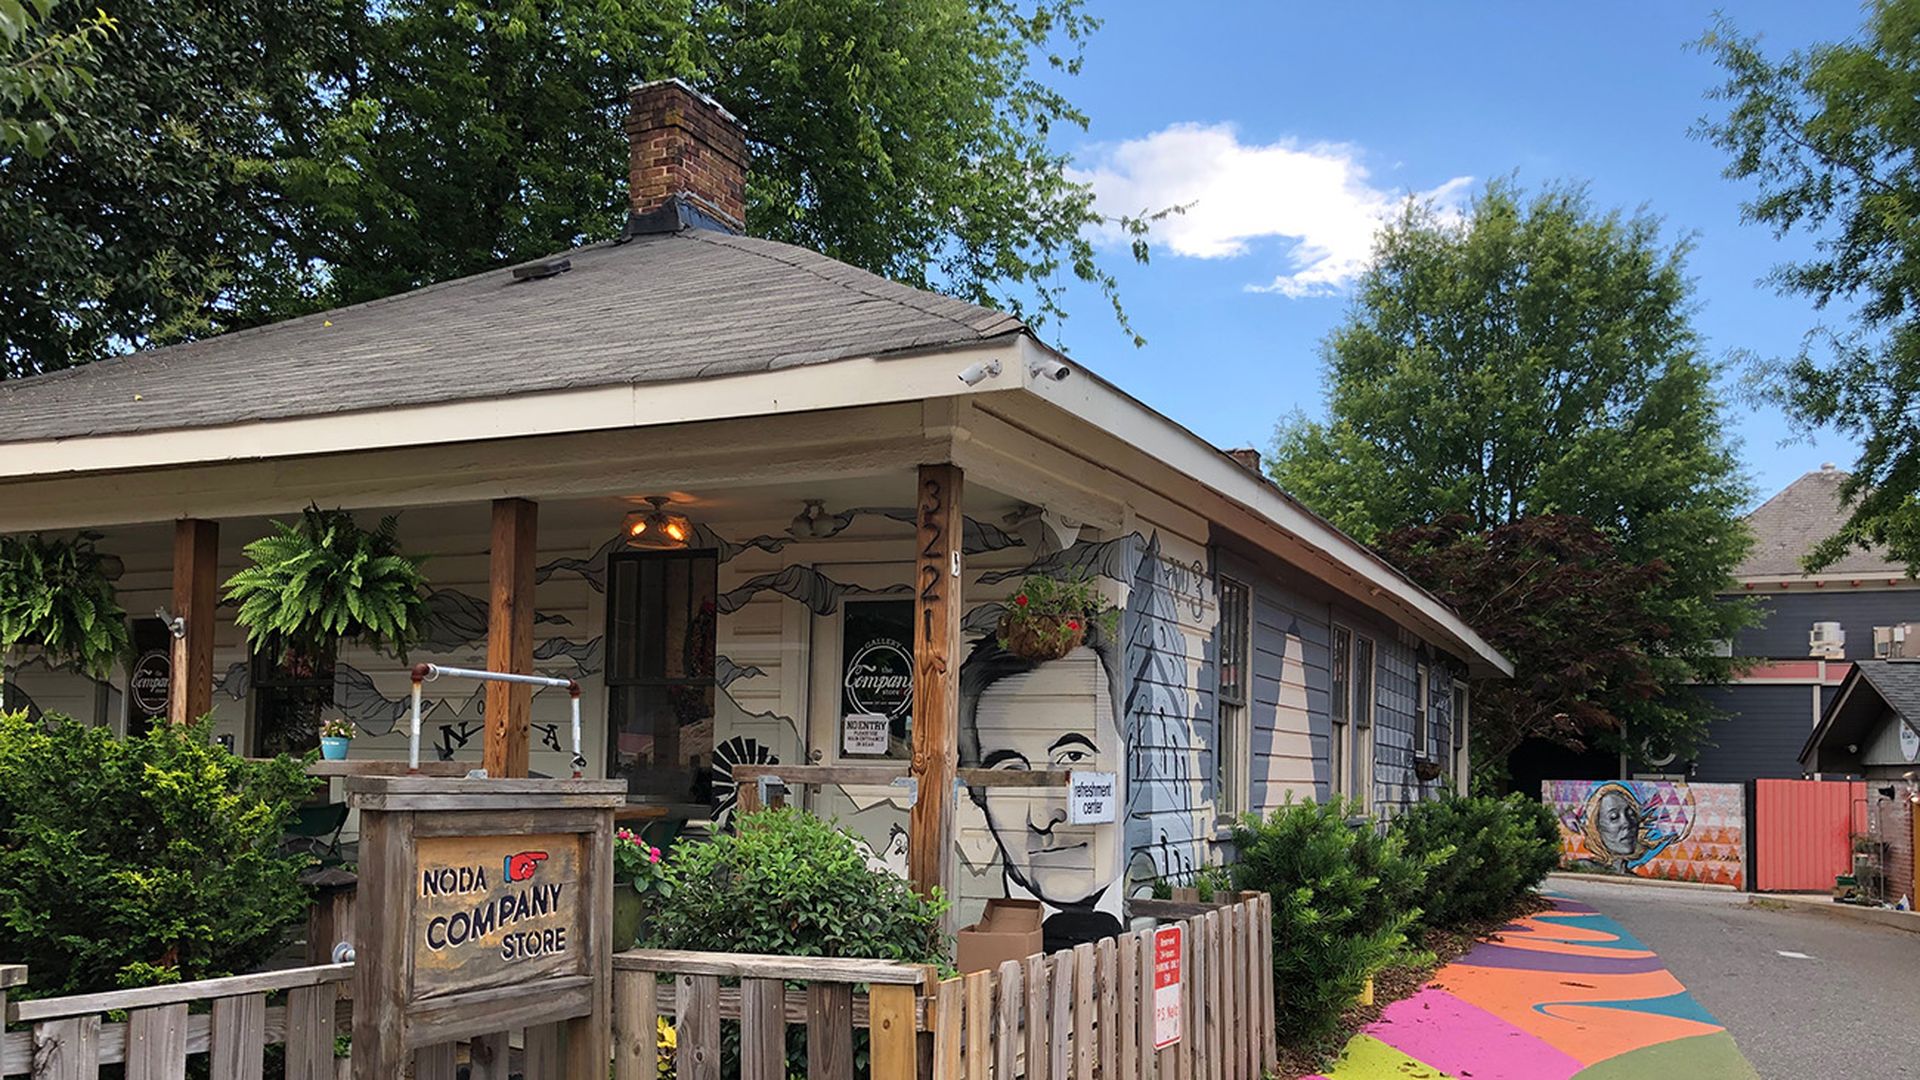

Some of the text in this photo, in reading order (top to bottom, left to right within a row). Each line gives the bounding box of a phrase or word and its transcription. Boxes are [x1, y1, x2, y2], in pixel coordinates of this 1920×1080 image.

[920, 479, 942, 642] 3221
[864, 638, 903, 649] GALLERY
[846, 720, 887, 730] NO ENTRY
[1074, 781, 1112, 798] refreshment
[1082, 799, 1104, 815] center
[421, 865, 488, 899] NODA
[425, 883, 563, 952] COMPANY
[500, 926, 567, 961] STORE
